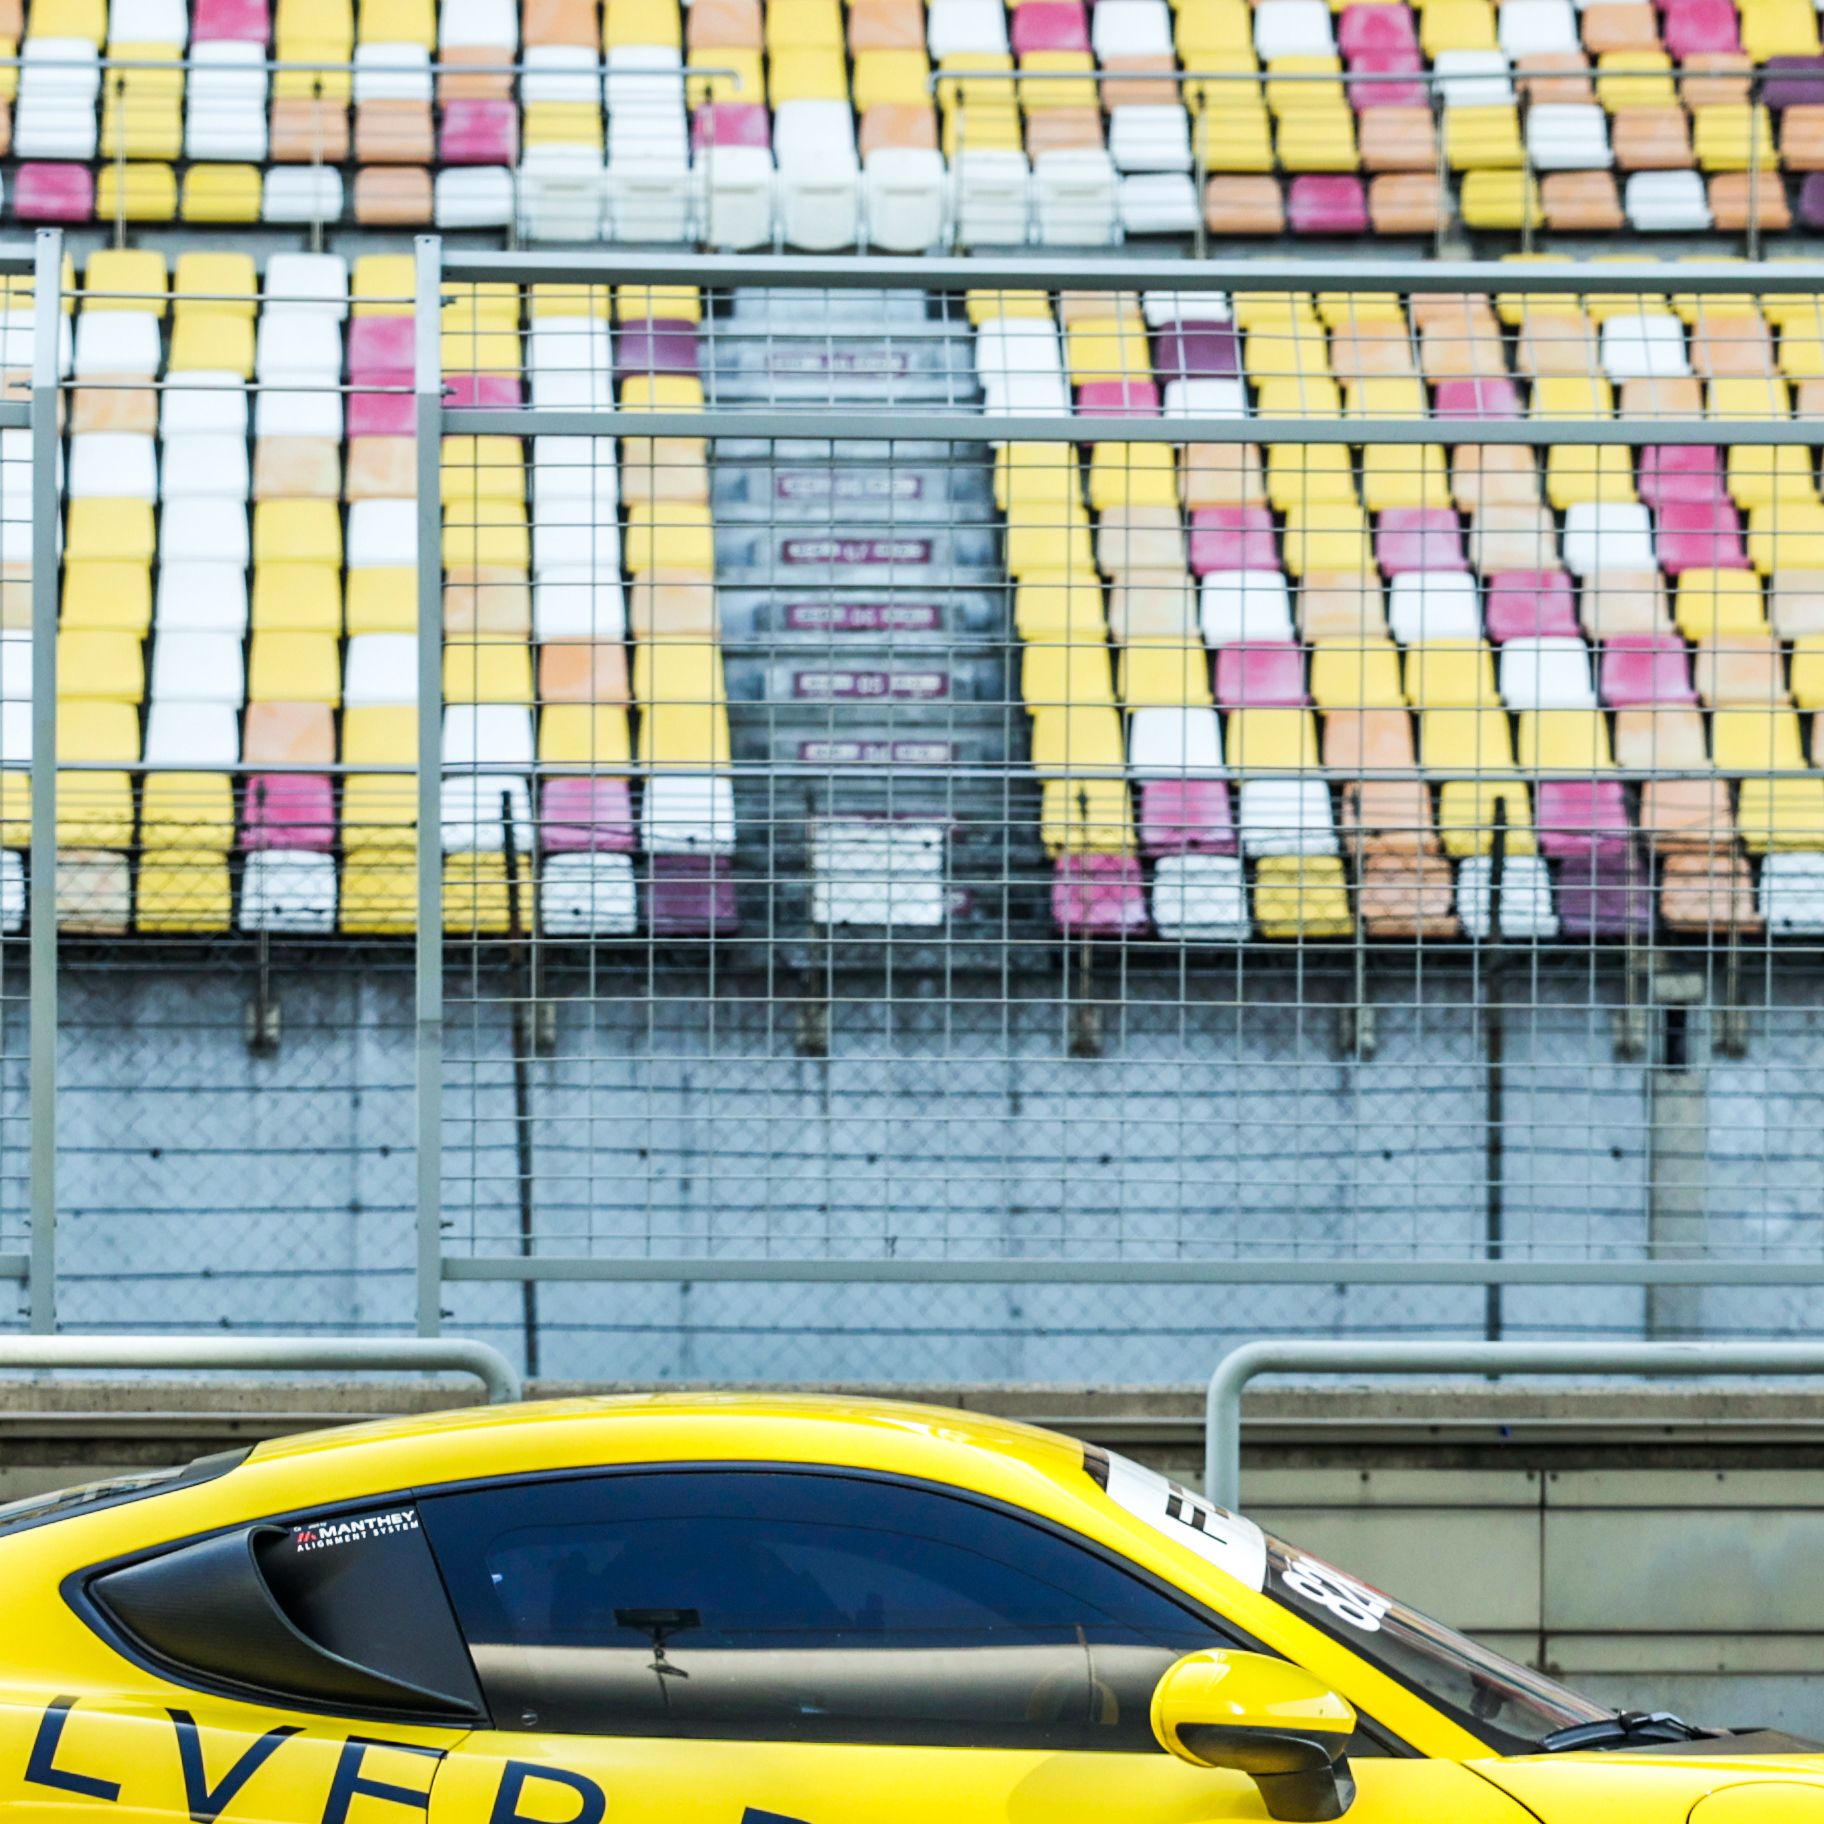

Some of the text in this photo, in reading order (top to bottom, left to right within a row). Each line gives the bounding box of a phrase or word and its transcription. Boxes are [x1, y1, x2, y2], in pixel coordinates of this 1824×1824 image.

[296, 1520, 419, 1552] ALIGNMENT SYSTEM
[318, 1509, 415, 1539] MANTHEY
